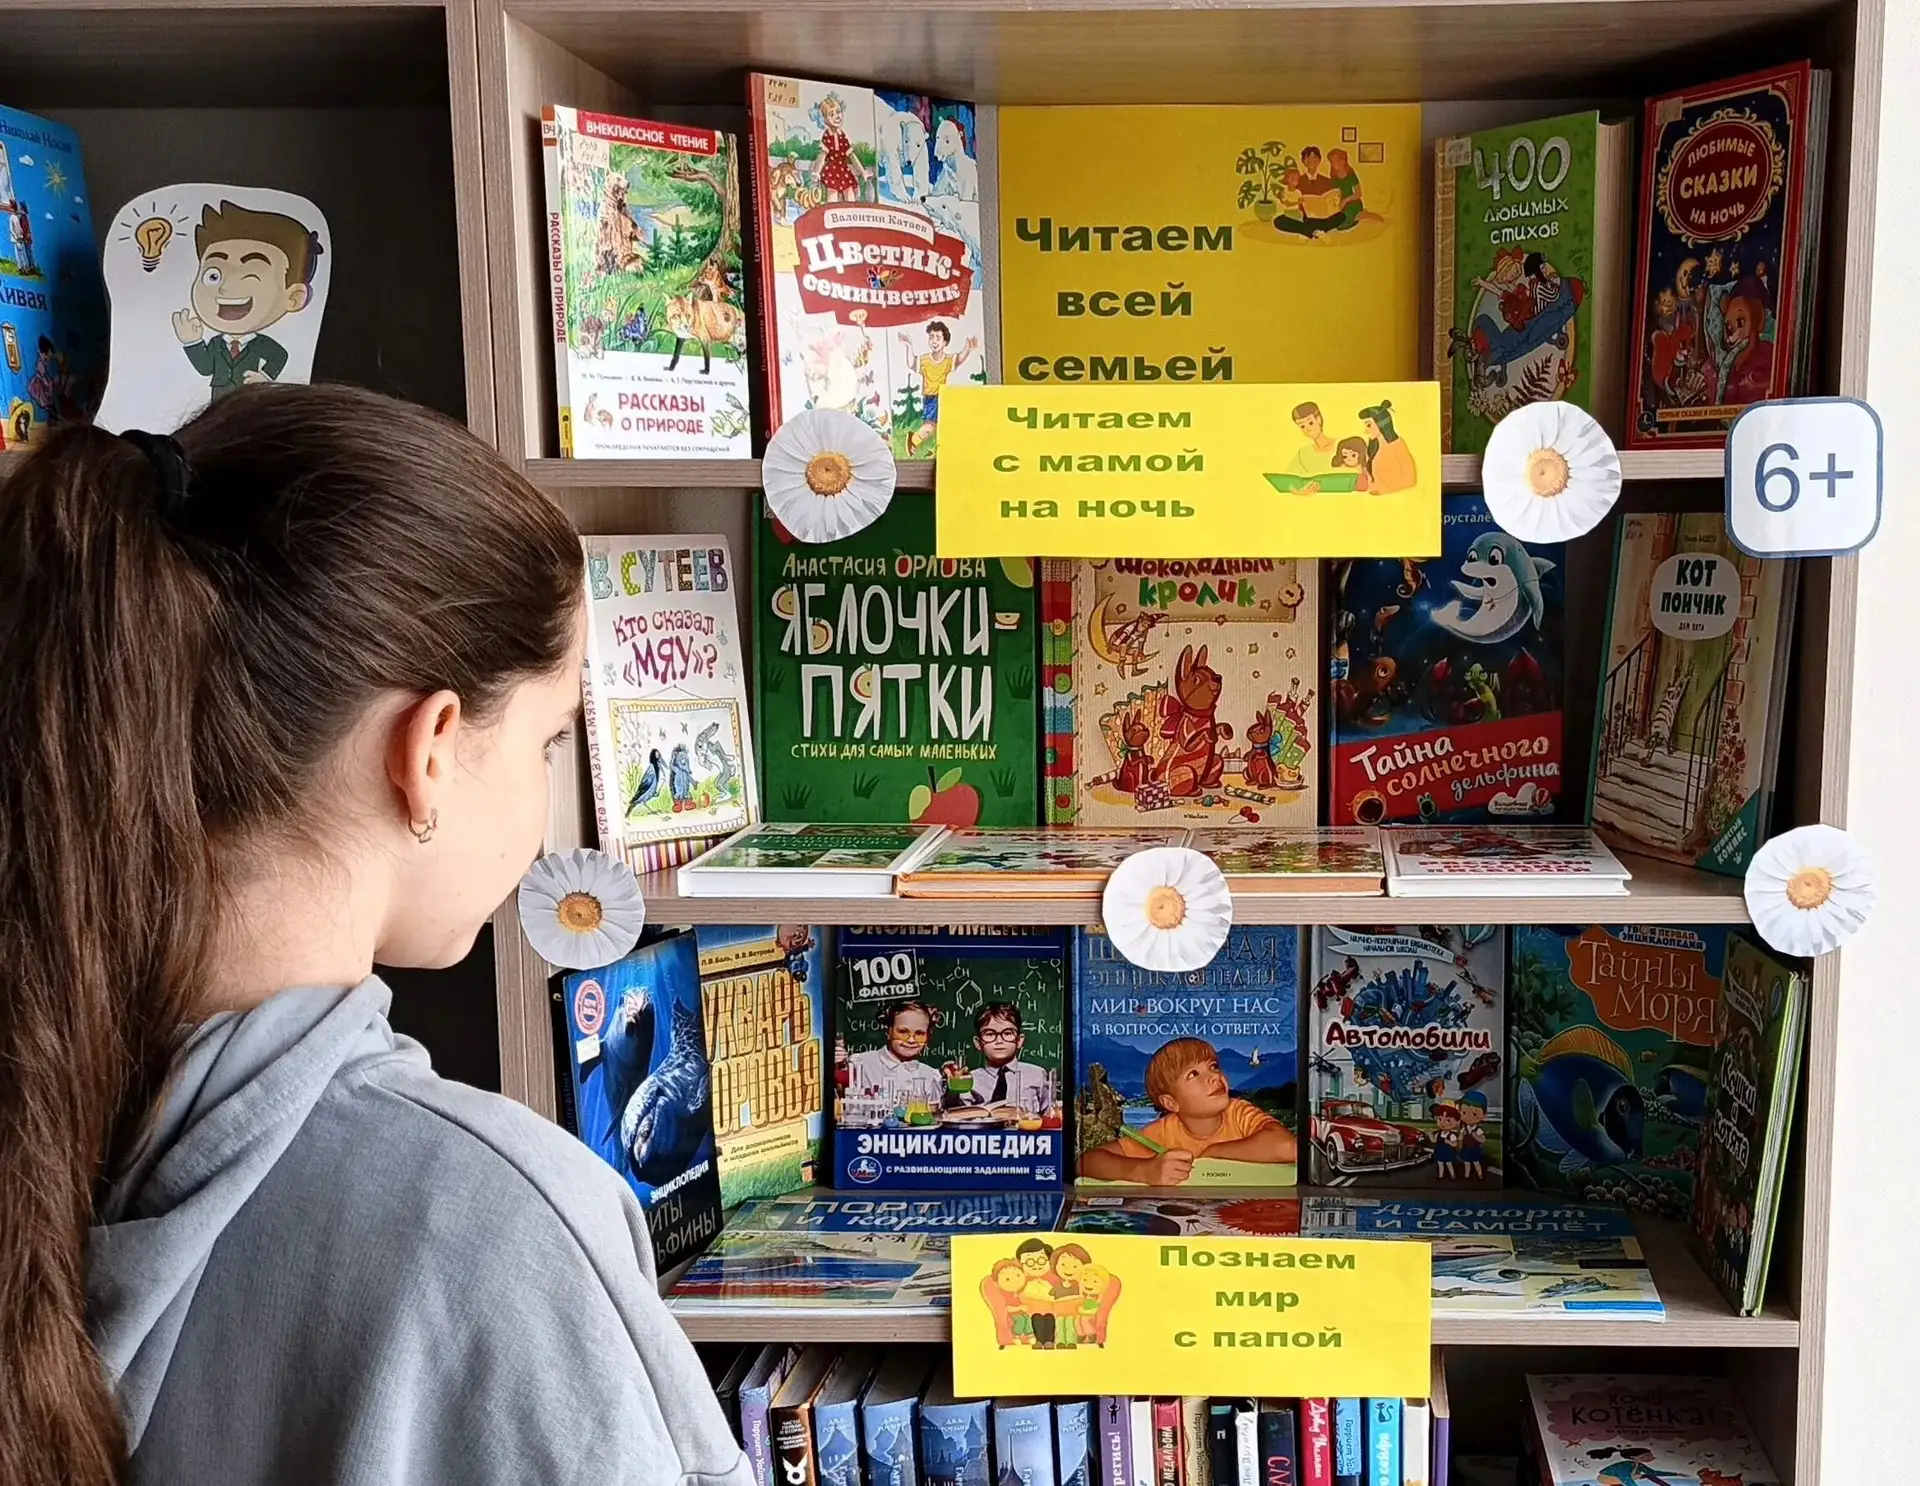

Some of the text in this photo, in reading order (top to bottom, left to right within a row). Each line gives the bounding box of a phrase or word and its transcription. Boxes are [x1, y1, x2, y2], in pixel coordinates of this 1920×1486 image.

[586, 121, 709, 151] ВНЕКЛАССНОЕ ЧТЕНИЕ
[1474, 137, 1571, 200] 400
[1688, 137, 1756, 168] ЛЮБИМЫЕ
[1680, 164, 1758, 199] СКАЗКИ
[830, 213, 928, 232] Валентин Катаев
[1690, 202, 1745, 224] НА НОЧЬ
[550, 212, 562, 271] РАССКАЗЫ
[1014, 217, 1234, 252] Читаем
[801, 233, 961, 280] Цветик-
[803, 273, 961, 308] семицветик
[1056, 281, 1193, 318] всей
[554, 287, 566, 343] ПРИРОДЕ
[1018, 346, 1234, 382] семьей
[618, 392, 705, 413] РАССКАЗЫ
[1006, 406, 1191, 430] Читаем
[621, 418, 704, 435] О ПРИРОДЕ
[993, 448, 1204, 473] с мамой
[1755, 443, 1853, 512] 6+
[1001, 498, 1195, 518] на ночь
[1441, 511, 1496, 526] русталё
[1676, 560, 1718, 587] КОТ
[1660, 592, 1728, 616] ПОНЧИК
[801, 663, 992, 741] ПЯТКИ
[791, 743, 998, 760] СТИХИ ДЛЯ САМЫХ МАЛЕНЬКИХ
[1350, 734, 1454, 782] Тайна
[1386, 735, 1550, 796] солнечного
[1451, 761, 1560, 801] дельфина
[1717, 827, 1747, 864] КОМИКС
[1622, 933, 1703, 949] ЭНЦИКЛОПЕДИЯ
[852, 953, 912, 987] 100
[1579, 938, 1697, 992] Тайны
[858, 983, 915, 998] ФАКТОВ
[701, 968, 811, 1062] УКВАРЬ
[1091, 998, 1279, 1017] МИР ВОКРУГ НАС
[1610, 983, 1715, 1043] Моря
[1092, 1023, 1280, 1035] В ВОПРОСАХ И ОТВЕТАХ
[1326, 1022, 1491, 1048] Автомобили
[711, 1039, 821, 1137] ОРОВЬЯ
[857, 1134, 1052, 1159] ЭНЦИКЛОПЕДИЯ
[650, 1160, 709, 1204] ЭНЦИКЛОПЕДИЯ
[894, 1166, 972, 1176] РАЗВИВАЮЩИМИ
[973, 1166, 1030, 1176] ЗАДАНИЯМИ
[645, 1194, 683, 1235] ИТЫ
[847, 1210, 1039, 1231] корабли
[1373, 1204, 1587, 1221] Аэропорт
[1417, 1219, 1608, 1233] САМОЛЁТ
[656, 1206, 716, 1265] ЬФИНЫ
[1160, 1246, 1356, 1270] Познаем
[1215, 1289, 1300, 1313] мир
[1173, 1327, 1343, 1348] с папой
[1108, 1432, 1126, 1486] регись!
[1162, 1426, 1175, 1477] МЕДАЛЬОНА
[1195, 1452, 1207, 1486] Уайтхор
